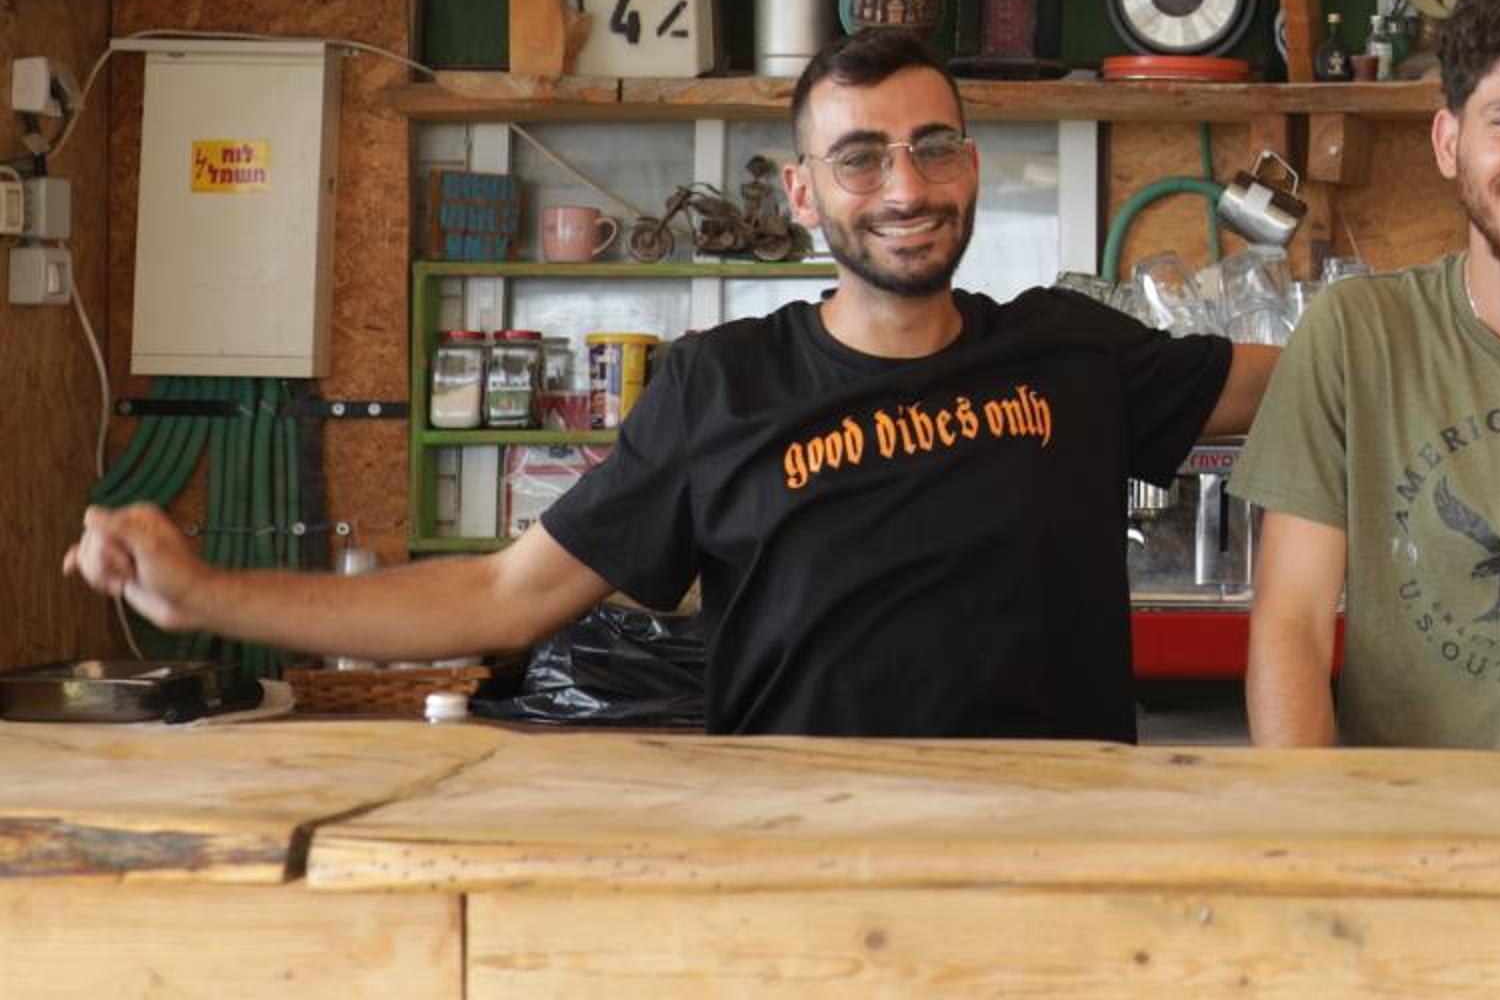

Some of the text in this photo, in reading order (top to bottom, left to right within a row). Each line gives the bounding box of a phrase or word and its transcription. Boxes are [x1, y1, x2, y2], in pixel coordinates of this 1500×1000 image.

[222, 144, 255, 163] לוח
[207, 164, 265, 185] חשמל
[784, 416, 864, 490] good
[983, 384, 1051, 448] only
